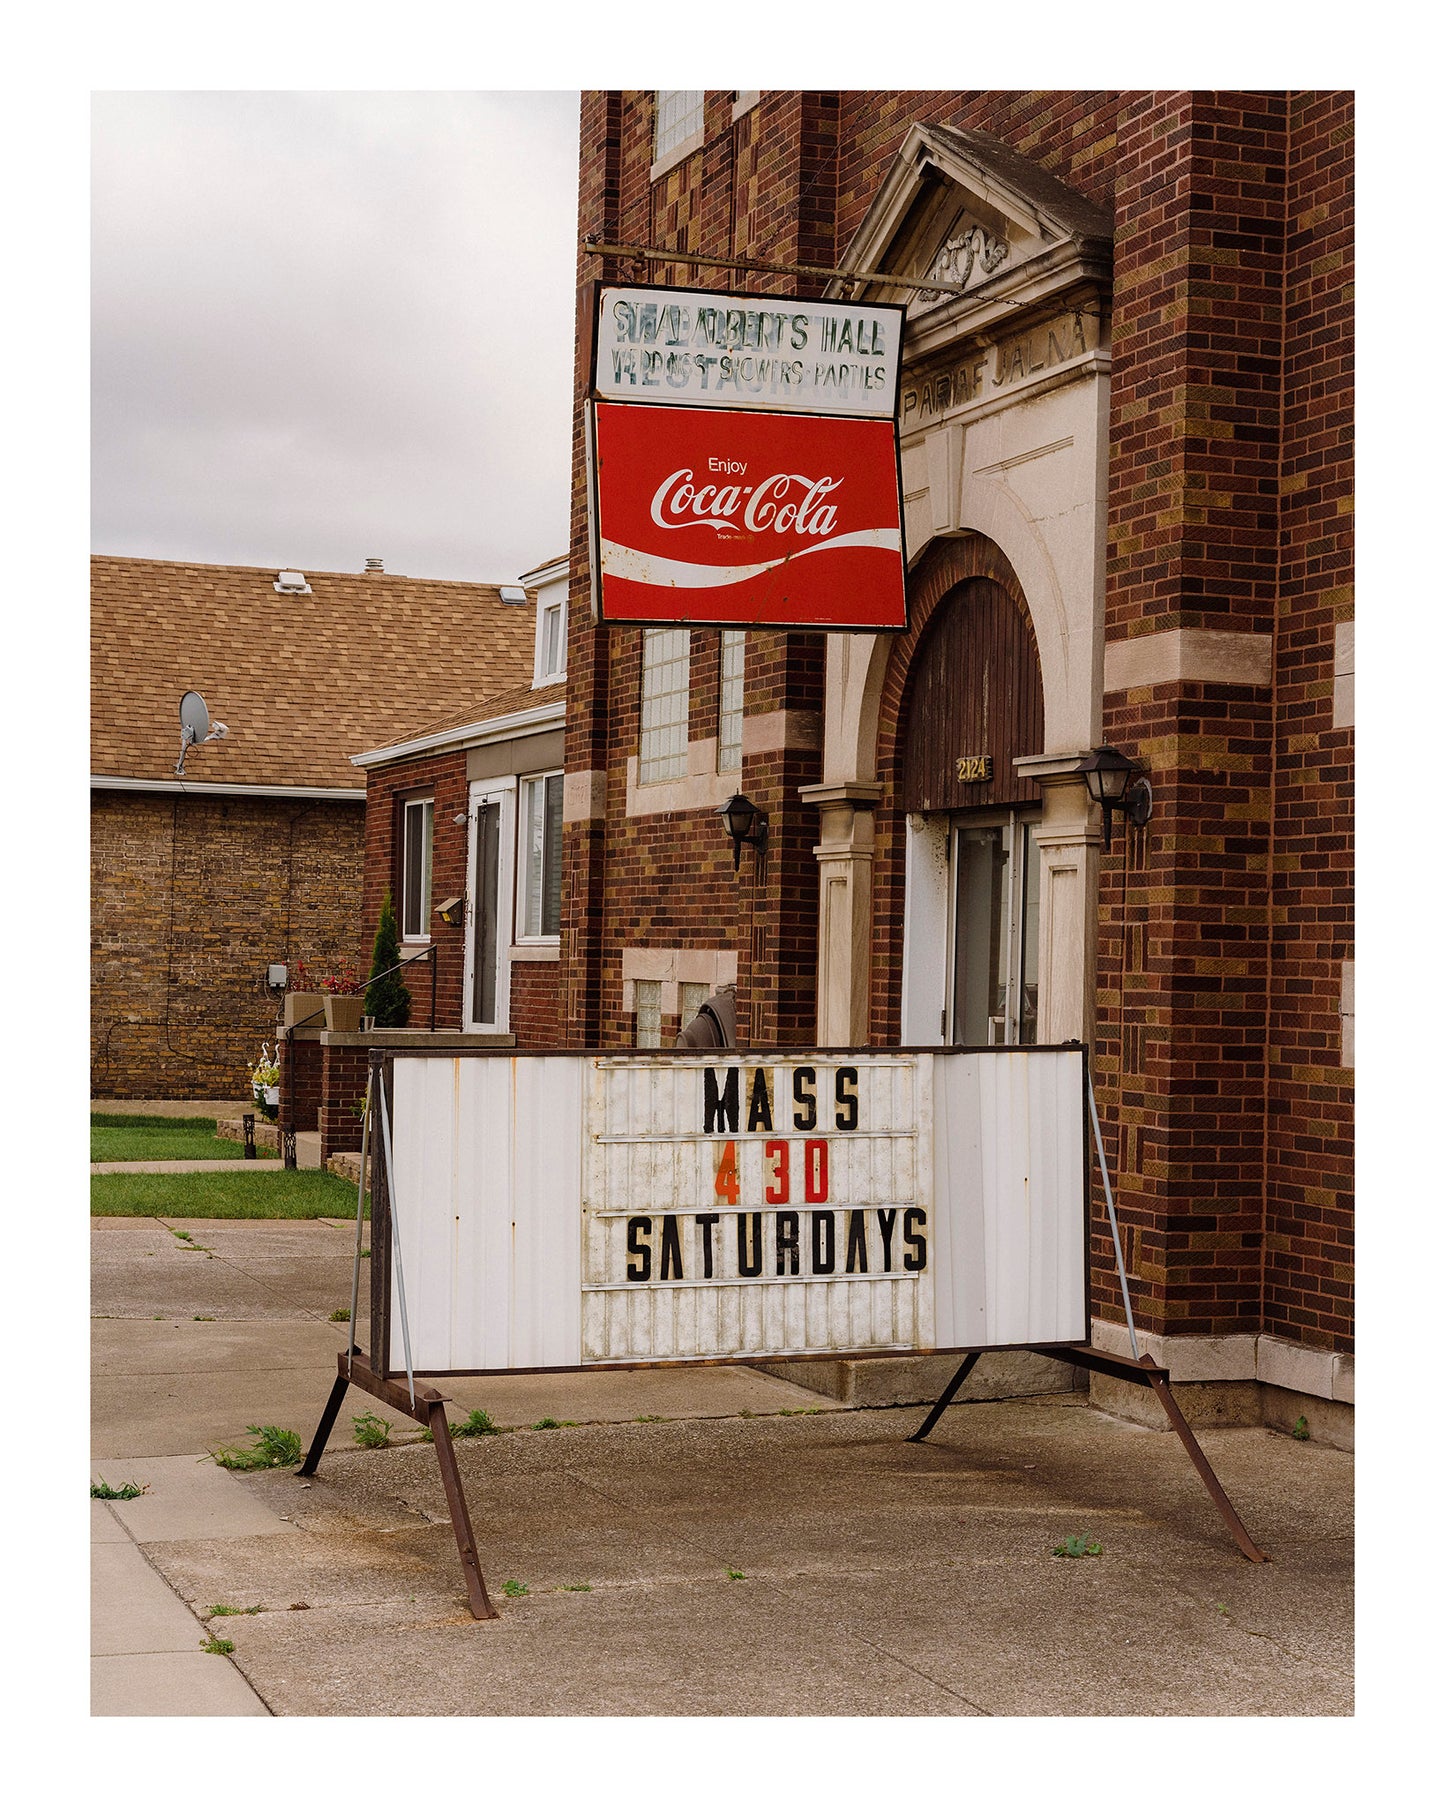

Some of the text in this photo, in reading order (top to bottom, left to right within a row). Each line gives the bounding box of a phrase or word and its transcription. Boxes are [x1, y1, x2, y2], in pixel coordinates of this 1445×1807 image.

[821, 316, 885, 356] HALL
[814, 362, 886, 391] PARTIES
[708, 457, 748, 476] Enjoy
[650, 468, 845, 536] Coca-Cola
[958, 757, 986, 780] 2124
[703, 1066, 859, 1133] MASS
[627, 1207, 927, 1282] SATURDAYS
